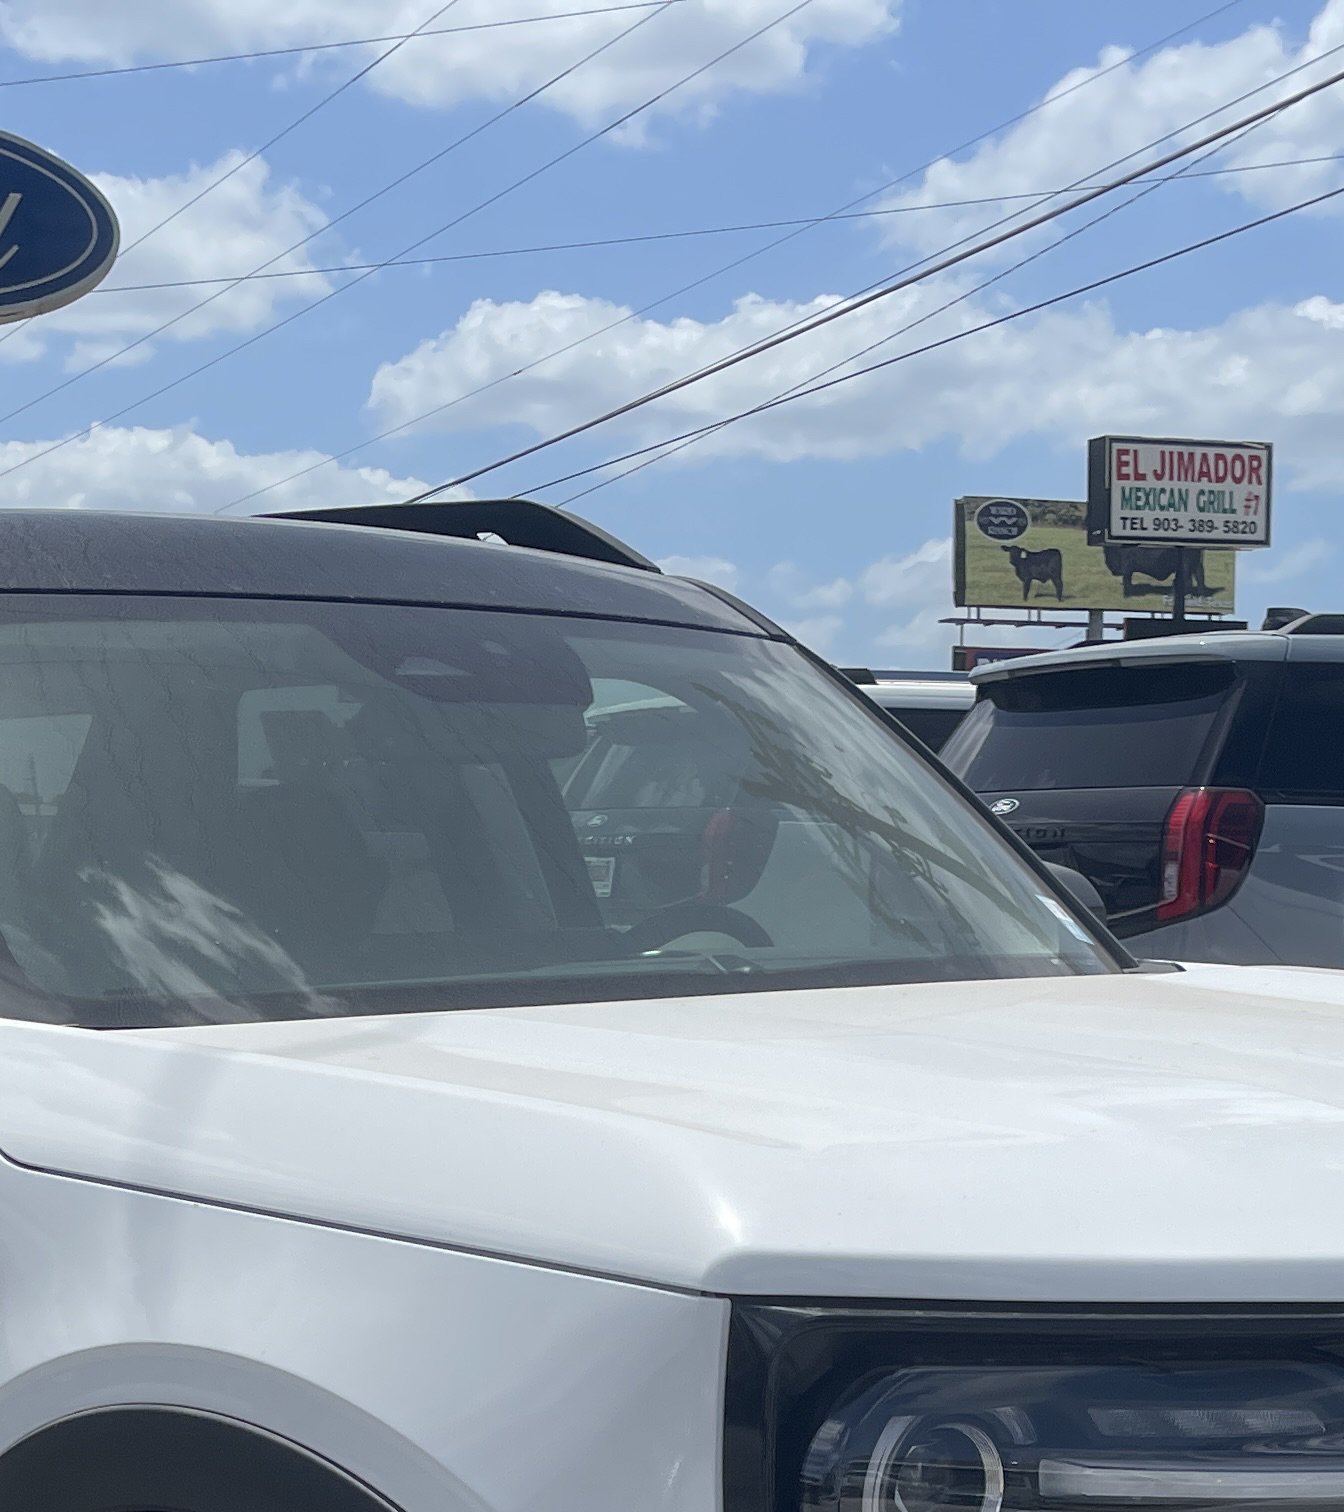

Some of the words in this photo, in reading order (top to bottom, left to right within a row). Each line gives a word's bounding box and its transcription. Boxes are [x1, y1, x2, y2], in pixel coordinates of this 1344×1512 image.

[1116, 448, 1147, 481] EL
[1152, 450, 1263, 486] JIMADOR
[1120, 486, 1189, 512] MEXICAN
[1196, 488, 1237, 514] GRILL
[1120, 517, 1148, 531] TEL
[1223, 520, 1258, 535] 5820
